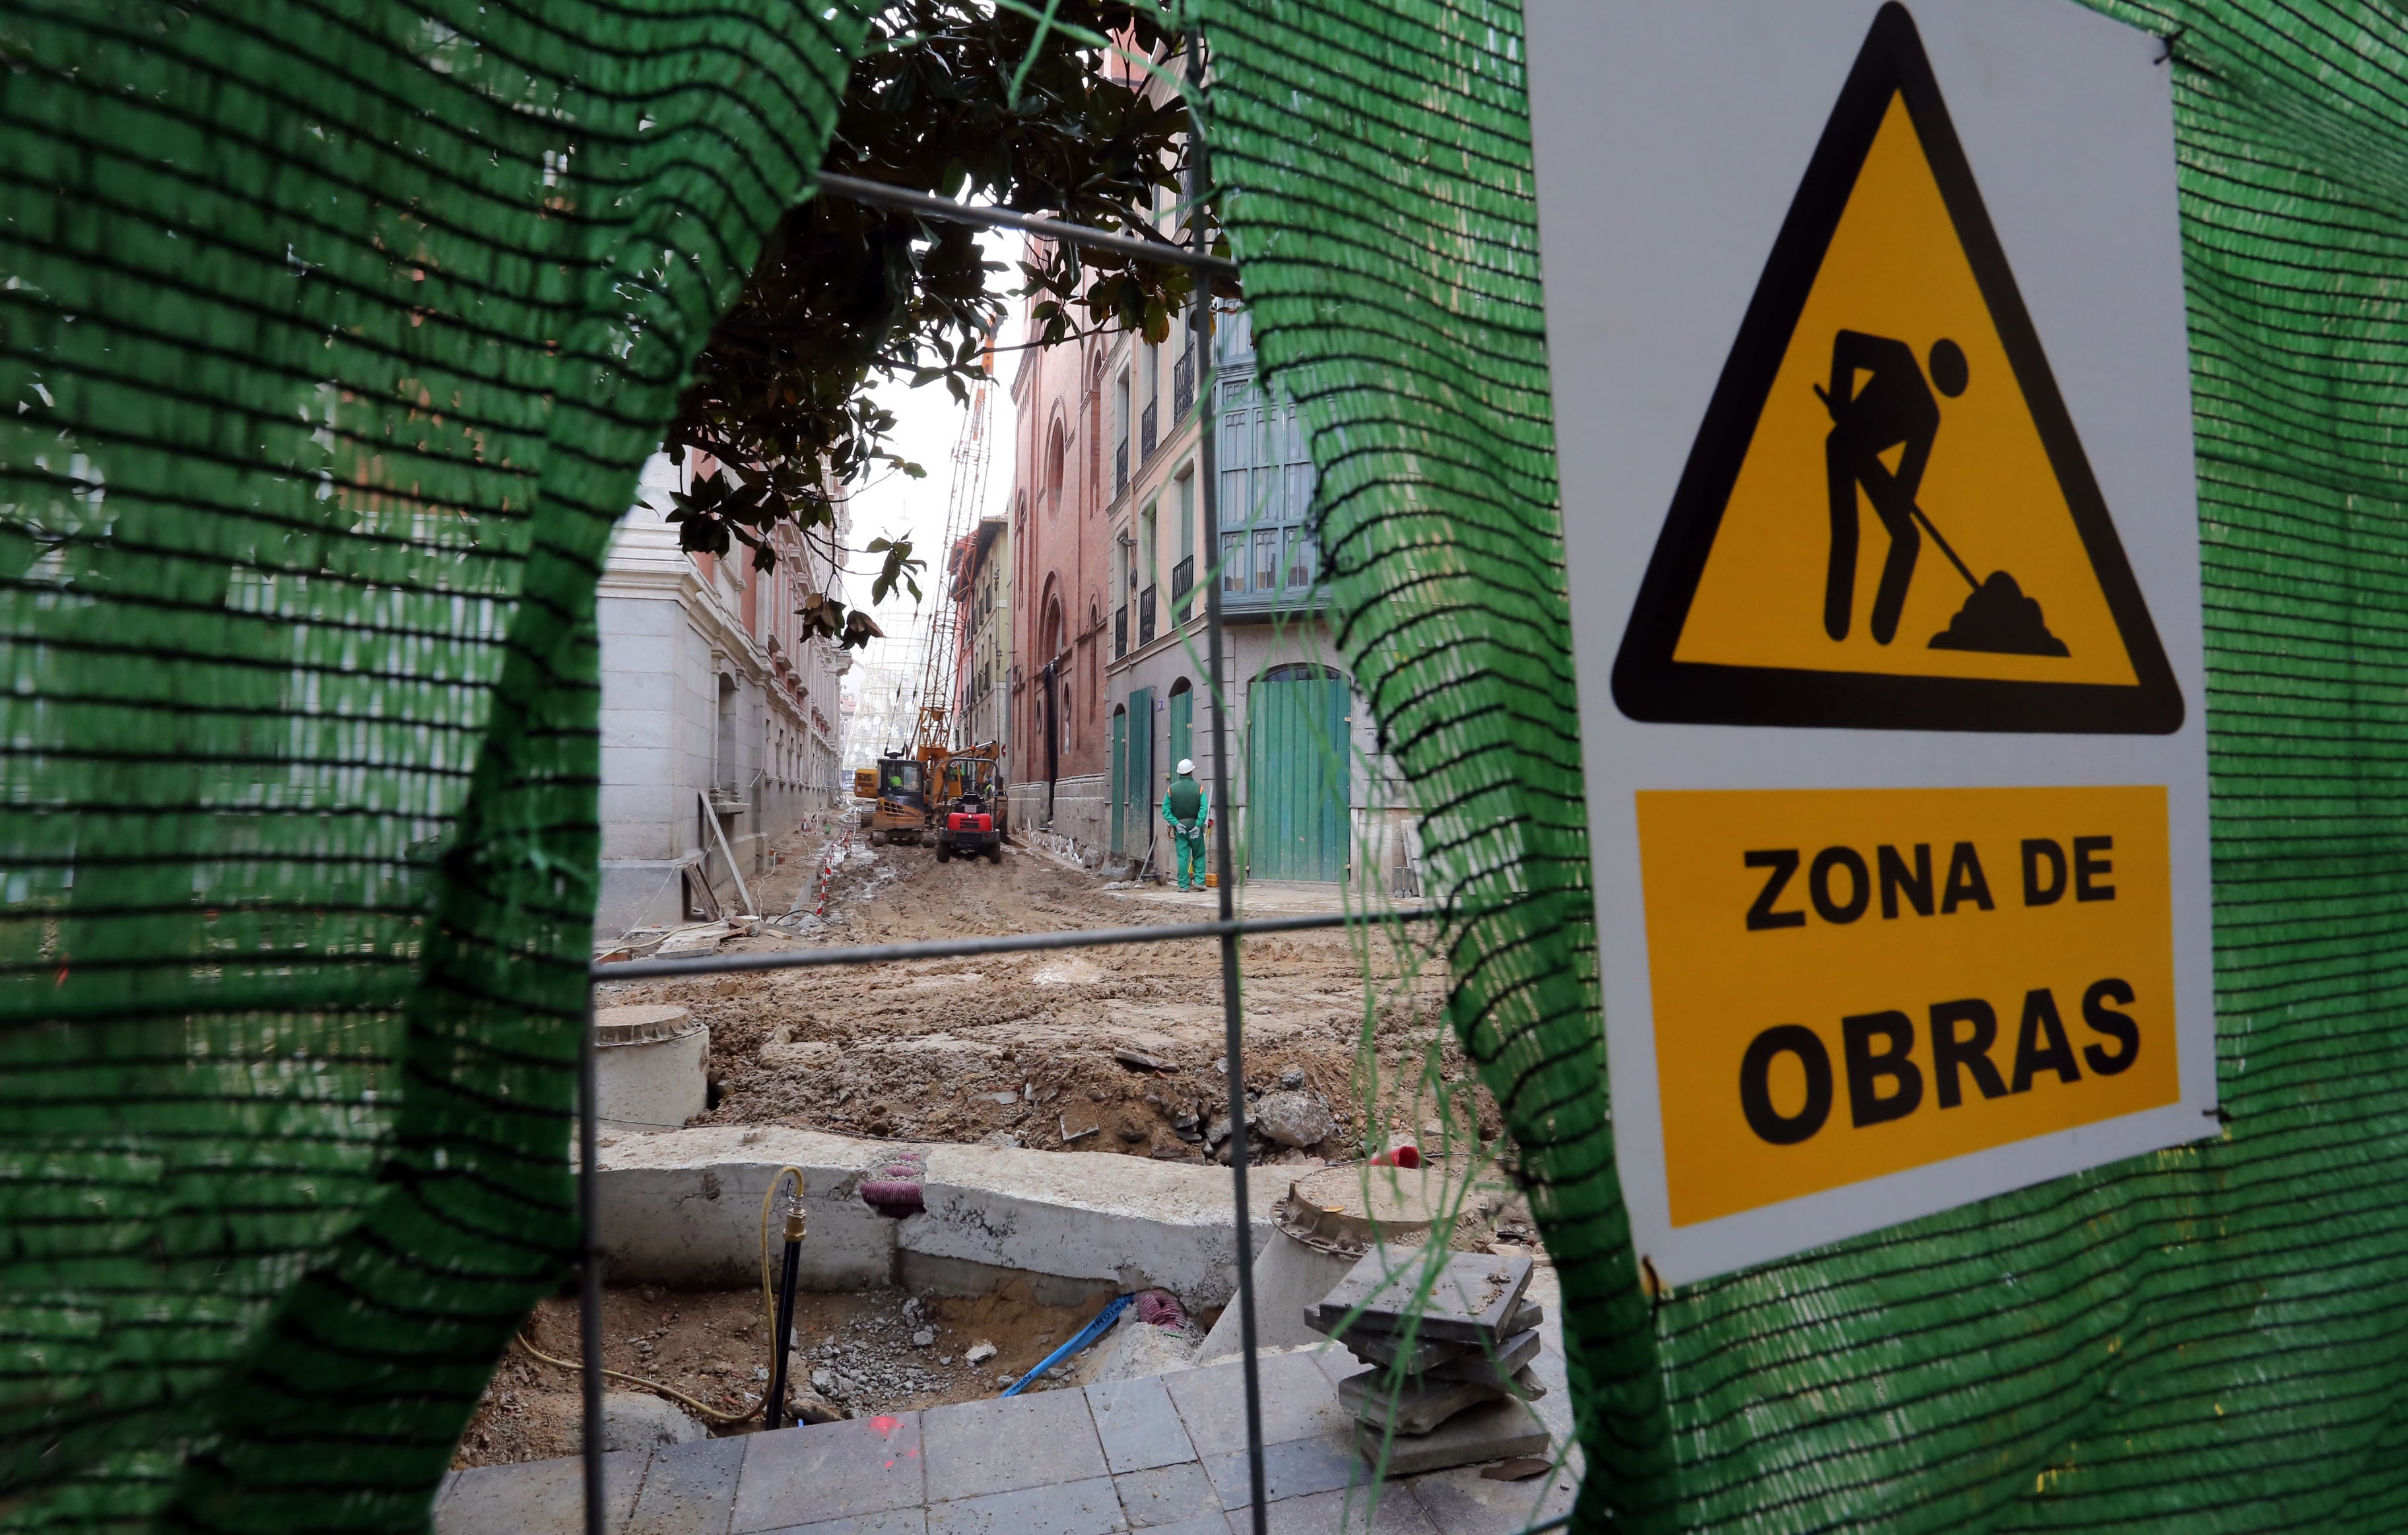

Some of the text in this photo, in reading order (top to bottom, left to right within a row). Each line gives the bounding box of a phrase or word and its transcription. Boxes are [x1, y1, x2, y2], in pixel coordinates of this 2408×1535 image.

[1743, 835, 2117, 932] ZONA DE
[1739, 978, 2141, 1146] OBRAS
